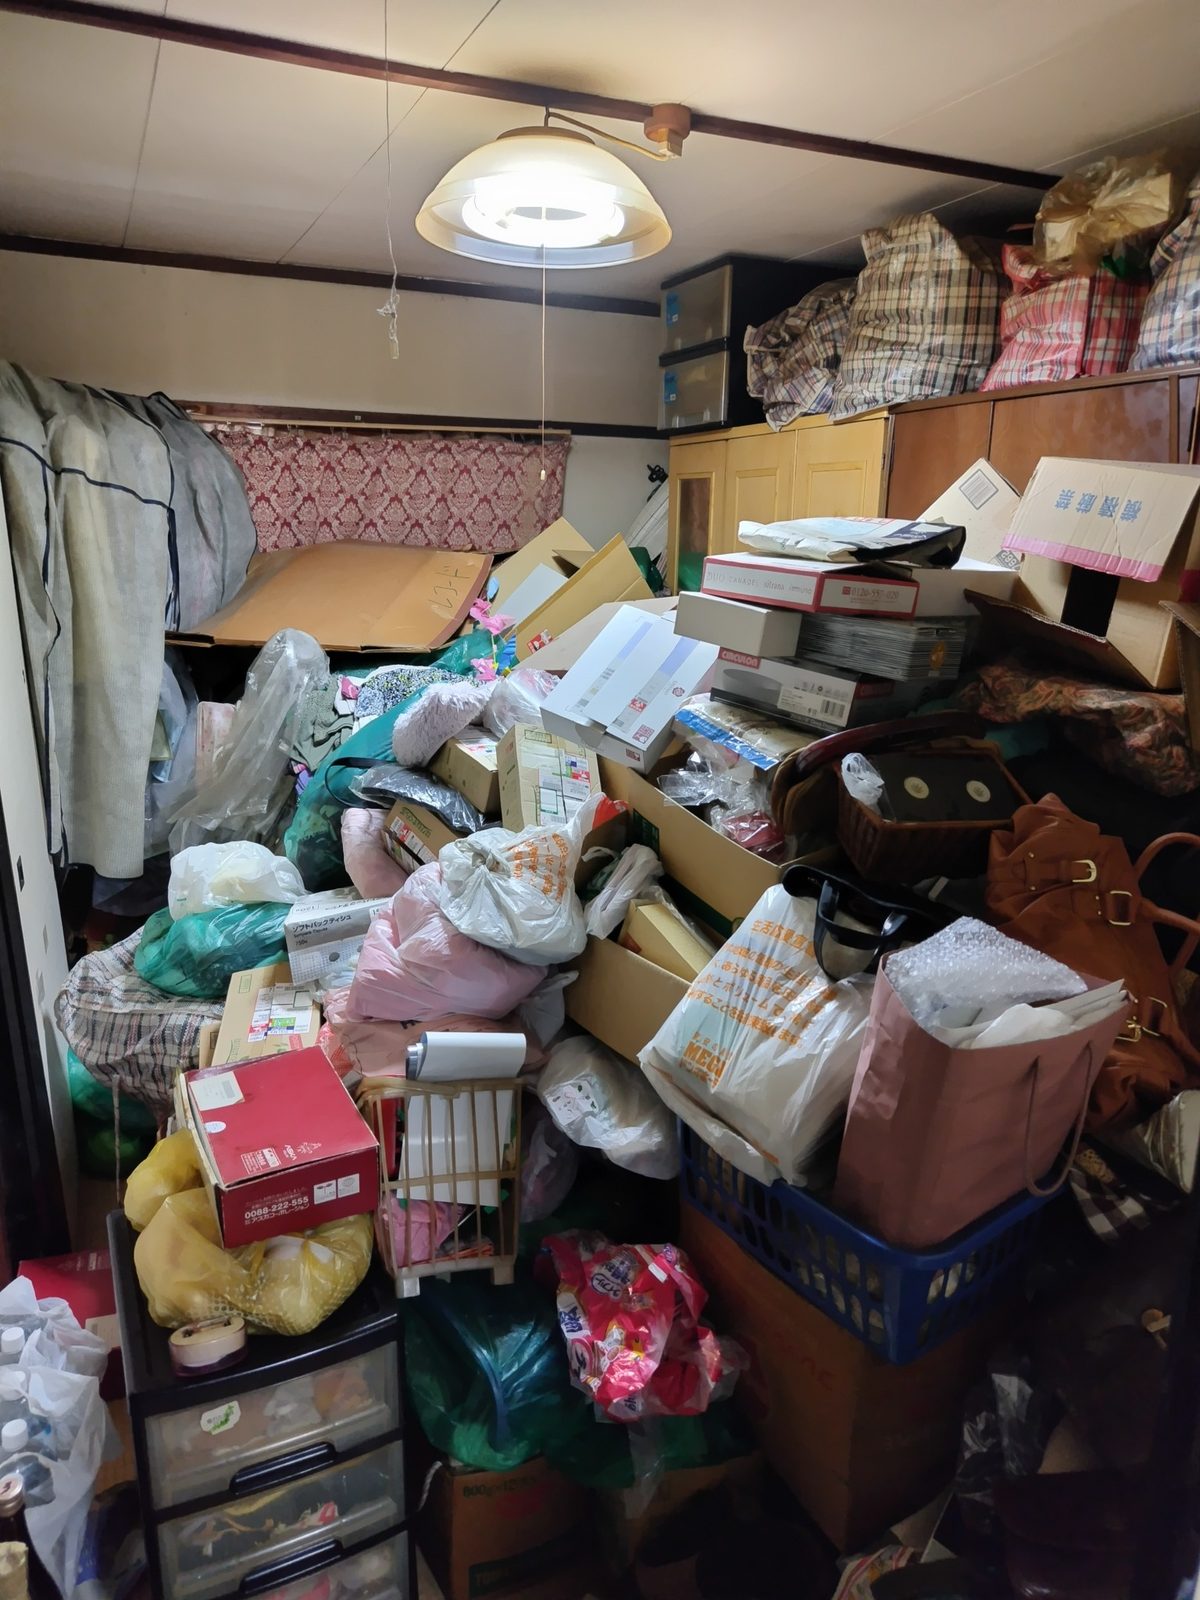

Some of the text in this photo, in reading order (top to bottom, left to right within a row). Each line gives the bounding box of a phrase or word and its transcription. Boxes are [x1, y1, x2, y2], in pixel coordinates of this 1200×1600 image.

[1054, 489, 1142, 522] 横積厳禁
[244, 1196, 309, 1219] 0088-222-555
